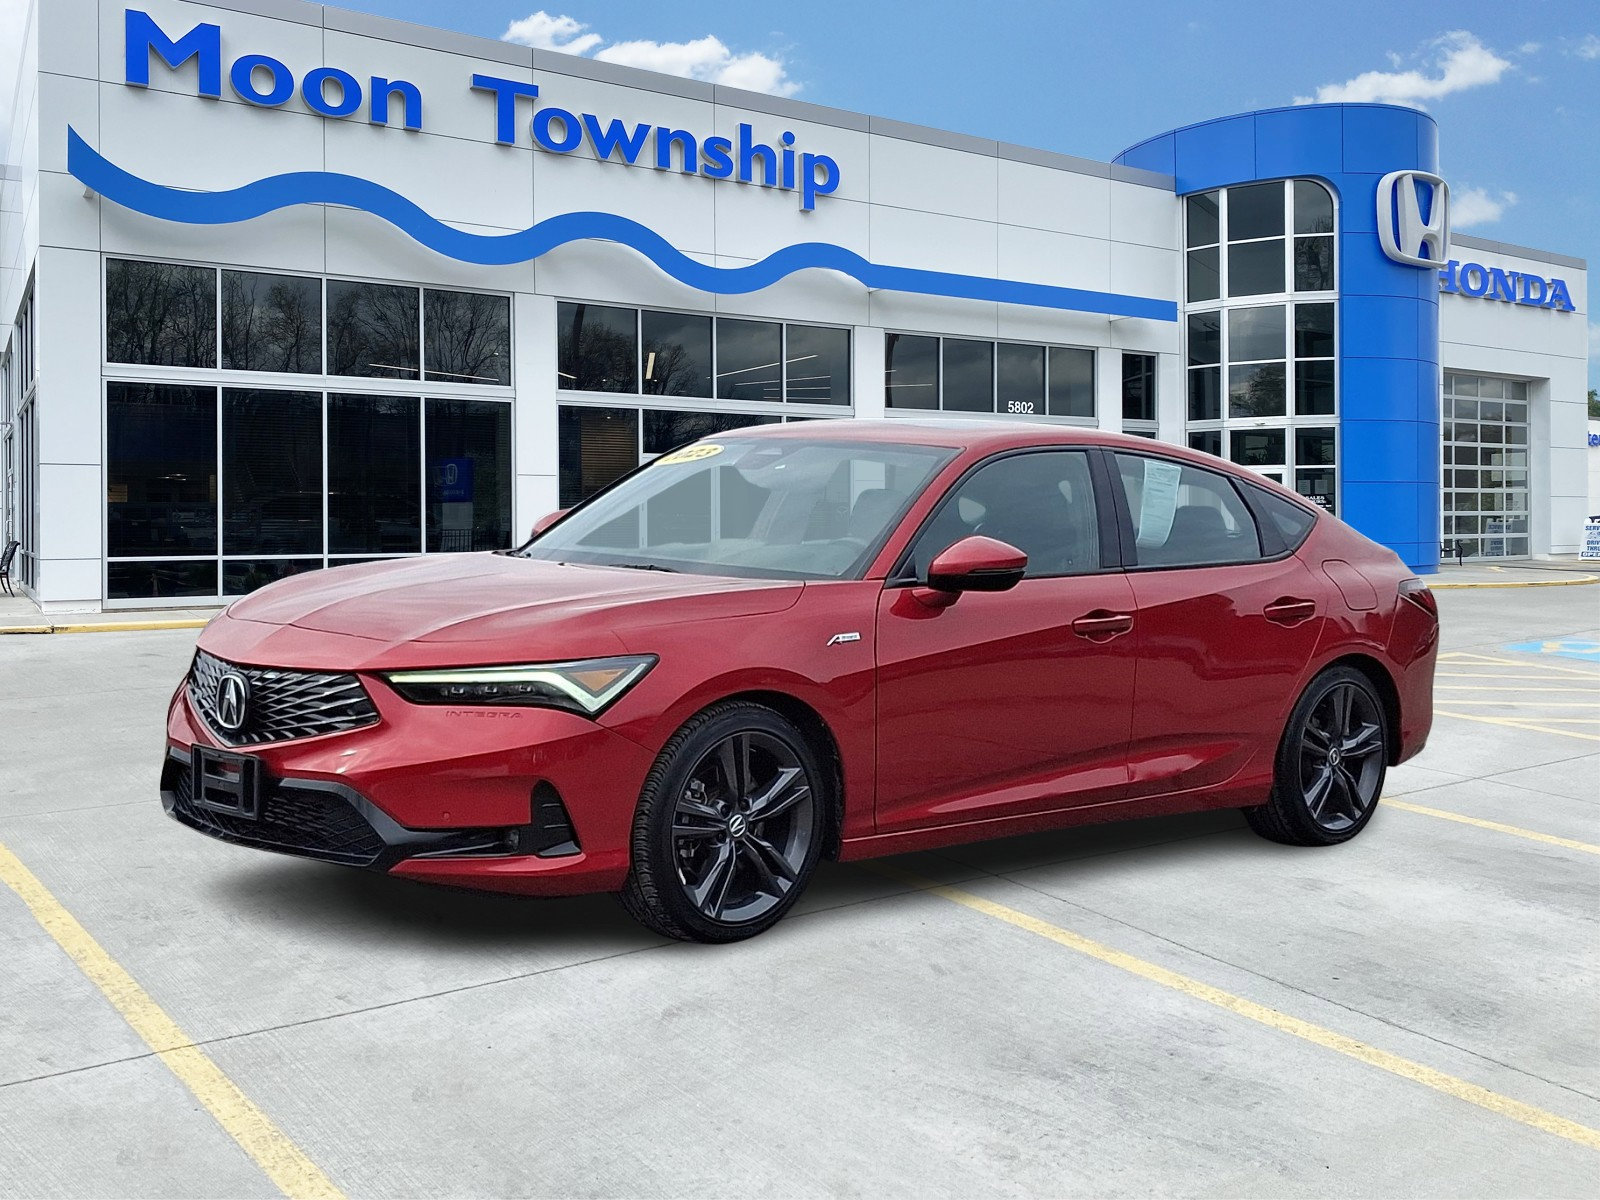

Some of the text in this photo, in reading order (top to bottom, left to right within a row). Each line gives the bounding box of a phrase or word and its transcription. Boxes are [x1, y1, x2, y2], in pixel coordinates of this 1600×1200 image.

[125, 9, 840, 212] Moon Township
[1008, 401, 1034, 413] 5802
[446, 710, 523, 719] INTEGRA
